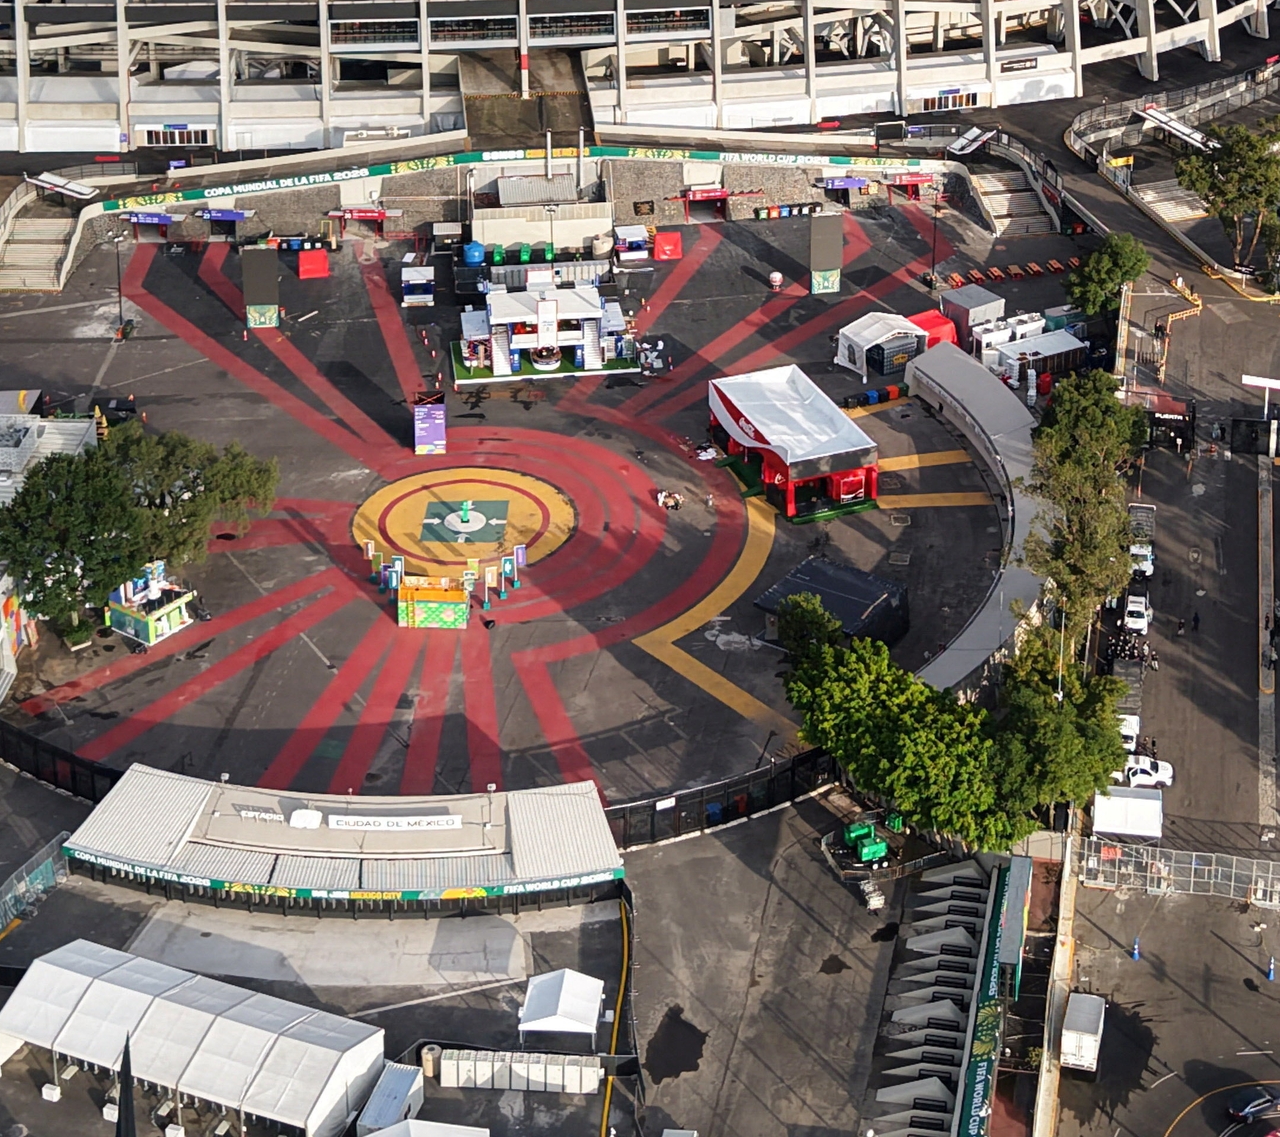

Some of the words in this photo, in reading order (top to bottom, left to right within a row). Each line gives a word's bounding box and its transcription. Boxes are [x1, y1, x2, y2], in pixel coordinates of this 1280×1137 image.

[720, 153, 740, 161] FIFA
[742, 153, 776, 163] WORLD
[776, 155, 796, 163] CUP
[796, 155, 830, 164] 2026
[204, 187, 232, 197] COPA
[233, 181, 279, 193] MUNDIAL
[280, 179, 294, 187] DE
[294, 176, 308, 185] LA
[309, 173, 332, 183] FIFA
[333, 168, 369, 181] 2026
[240, 811, 284, 821] ESTADIO
[336, 819, 382, 827] CIUDAD
[386, 819, 403, 827] DE
[406, 817, 455, 827] MÉXICO
[74, 851, 97, 863] COPA
[97, 857, 134, 873] MUNDIAL
[134, 866, 146, 875] DE
[147, 869, 159, 878] LA
[159, 871, 179, 881] FIFA
[180, 875, 211, 887] 2026
[503, 884, 525, 894] FIFA
[525, 880, 560, 892] WORLD
[560, 877, 580, 887] CUP
[976, 1062, 988, 1083] FIFA
[970, 1082, 985, 1117] WORLD
[968, 1116, 980, 1135] CUP
